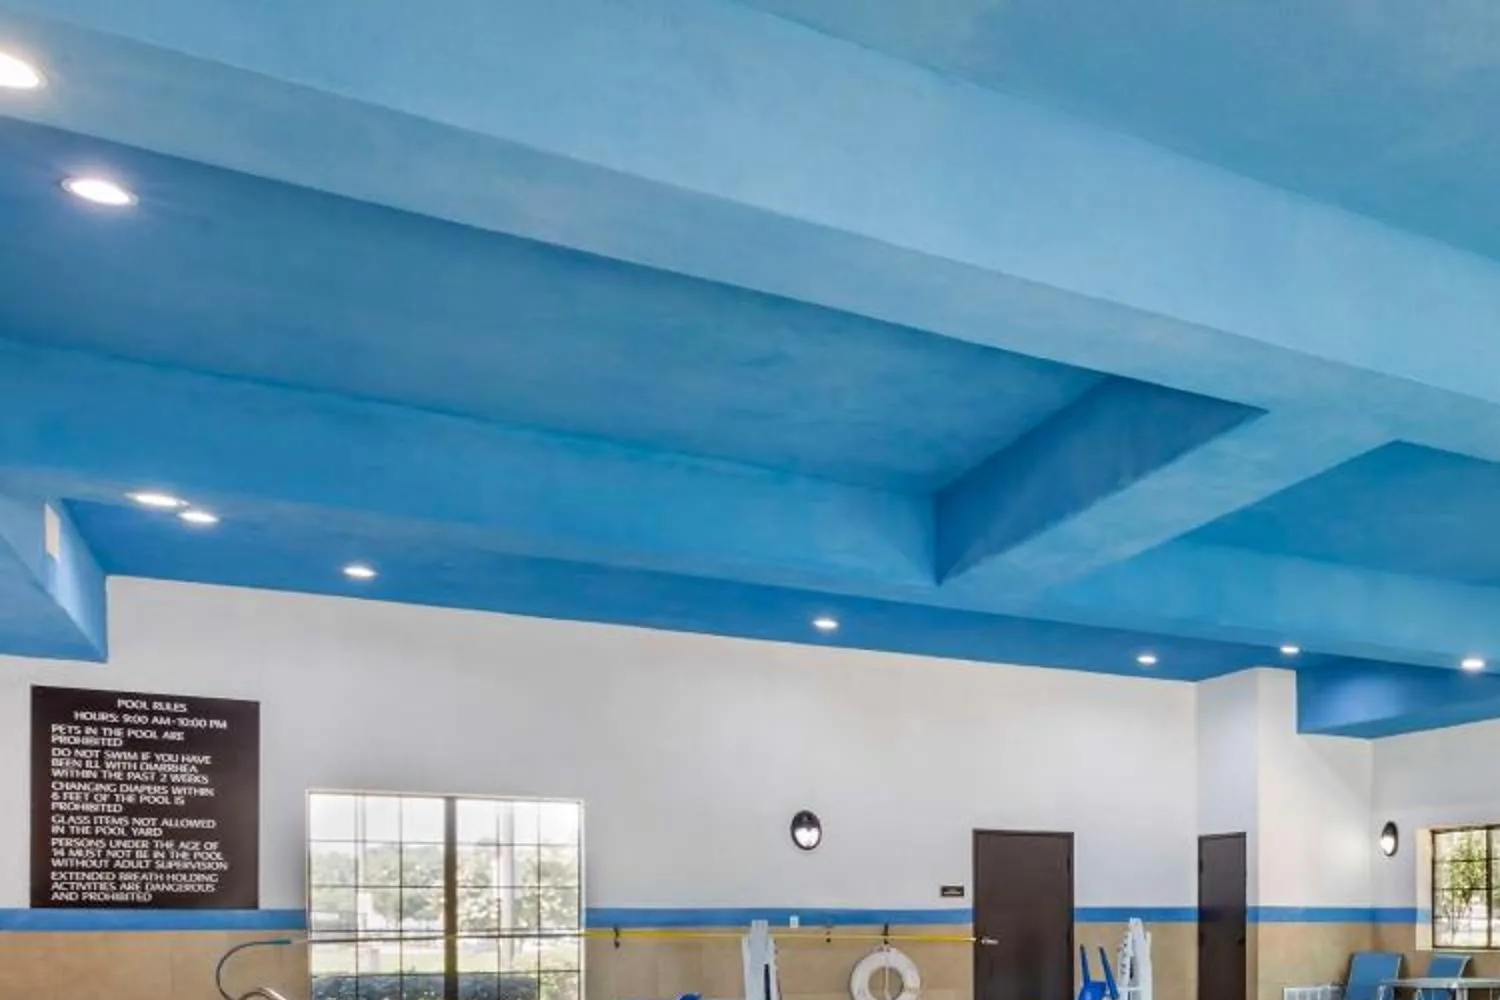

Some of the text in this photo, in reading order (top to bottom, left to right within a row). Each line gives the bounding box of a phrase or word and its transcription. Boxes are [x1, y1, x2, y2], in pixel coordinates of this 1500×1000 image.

[117, 699, 187, 713] POOL RULES
[122, 714, 148, 724] 9:00
[210, 720, 227, 730] PM
[51, 724, 185, 741] PETS IN THE POOL ARE
[51, 735, 123, 747] PROHIBITED
[51, 748, 212, 765] DO NOT SWIM IF YOU HAVE
[51, 758, 82, 769] BEEN
[85, 760, 100, 769] ILL
[104, 761, 137, 771] WITH
[51, 768, 209, 785] WITHIN THE PAST 2 WEEKS
[51, 781, 215, 797] CHANGING DIAPERS WITHIN
[63, 792, 89, 802] FEET
[94, 793, 111, 803] OF
[114, 794, 136, 804] THE
[139, 795, 172, 805] POOL
[174, 796, 185, 806] IS
[51, 801, 123, 813] PROHIBITED
[51, 815, 217, 829] GLASS ITEMS NOT ALLOWED
[51, 825, 163, 837] IN THE POOL YARD
[51, 837, 220, 851] PERSONS UNDER THE AGE OF
[68, 849, 101, 858] MUST
[106, 850, 132, 859] NOT
[135, 850, 149, 859] BE
[153, 851, 165, 859] IN
[170, 851, 190, 860] THE
[193, 851, 224, 861] POOL
[51, 858, 228, 871] WITHOUT ADULT SUPERVISION
[51, 871, 116, 881] EXTENDED
[166, 873, 219, 883] HOLDING
[51, 881, 117, 891] ACTIVITIES
[120, 882, 141, 891] ARE
[51, 892, 152, 901] AND PROHIBITED
